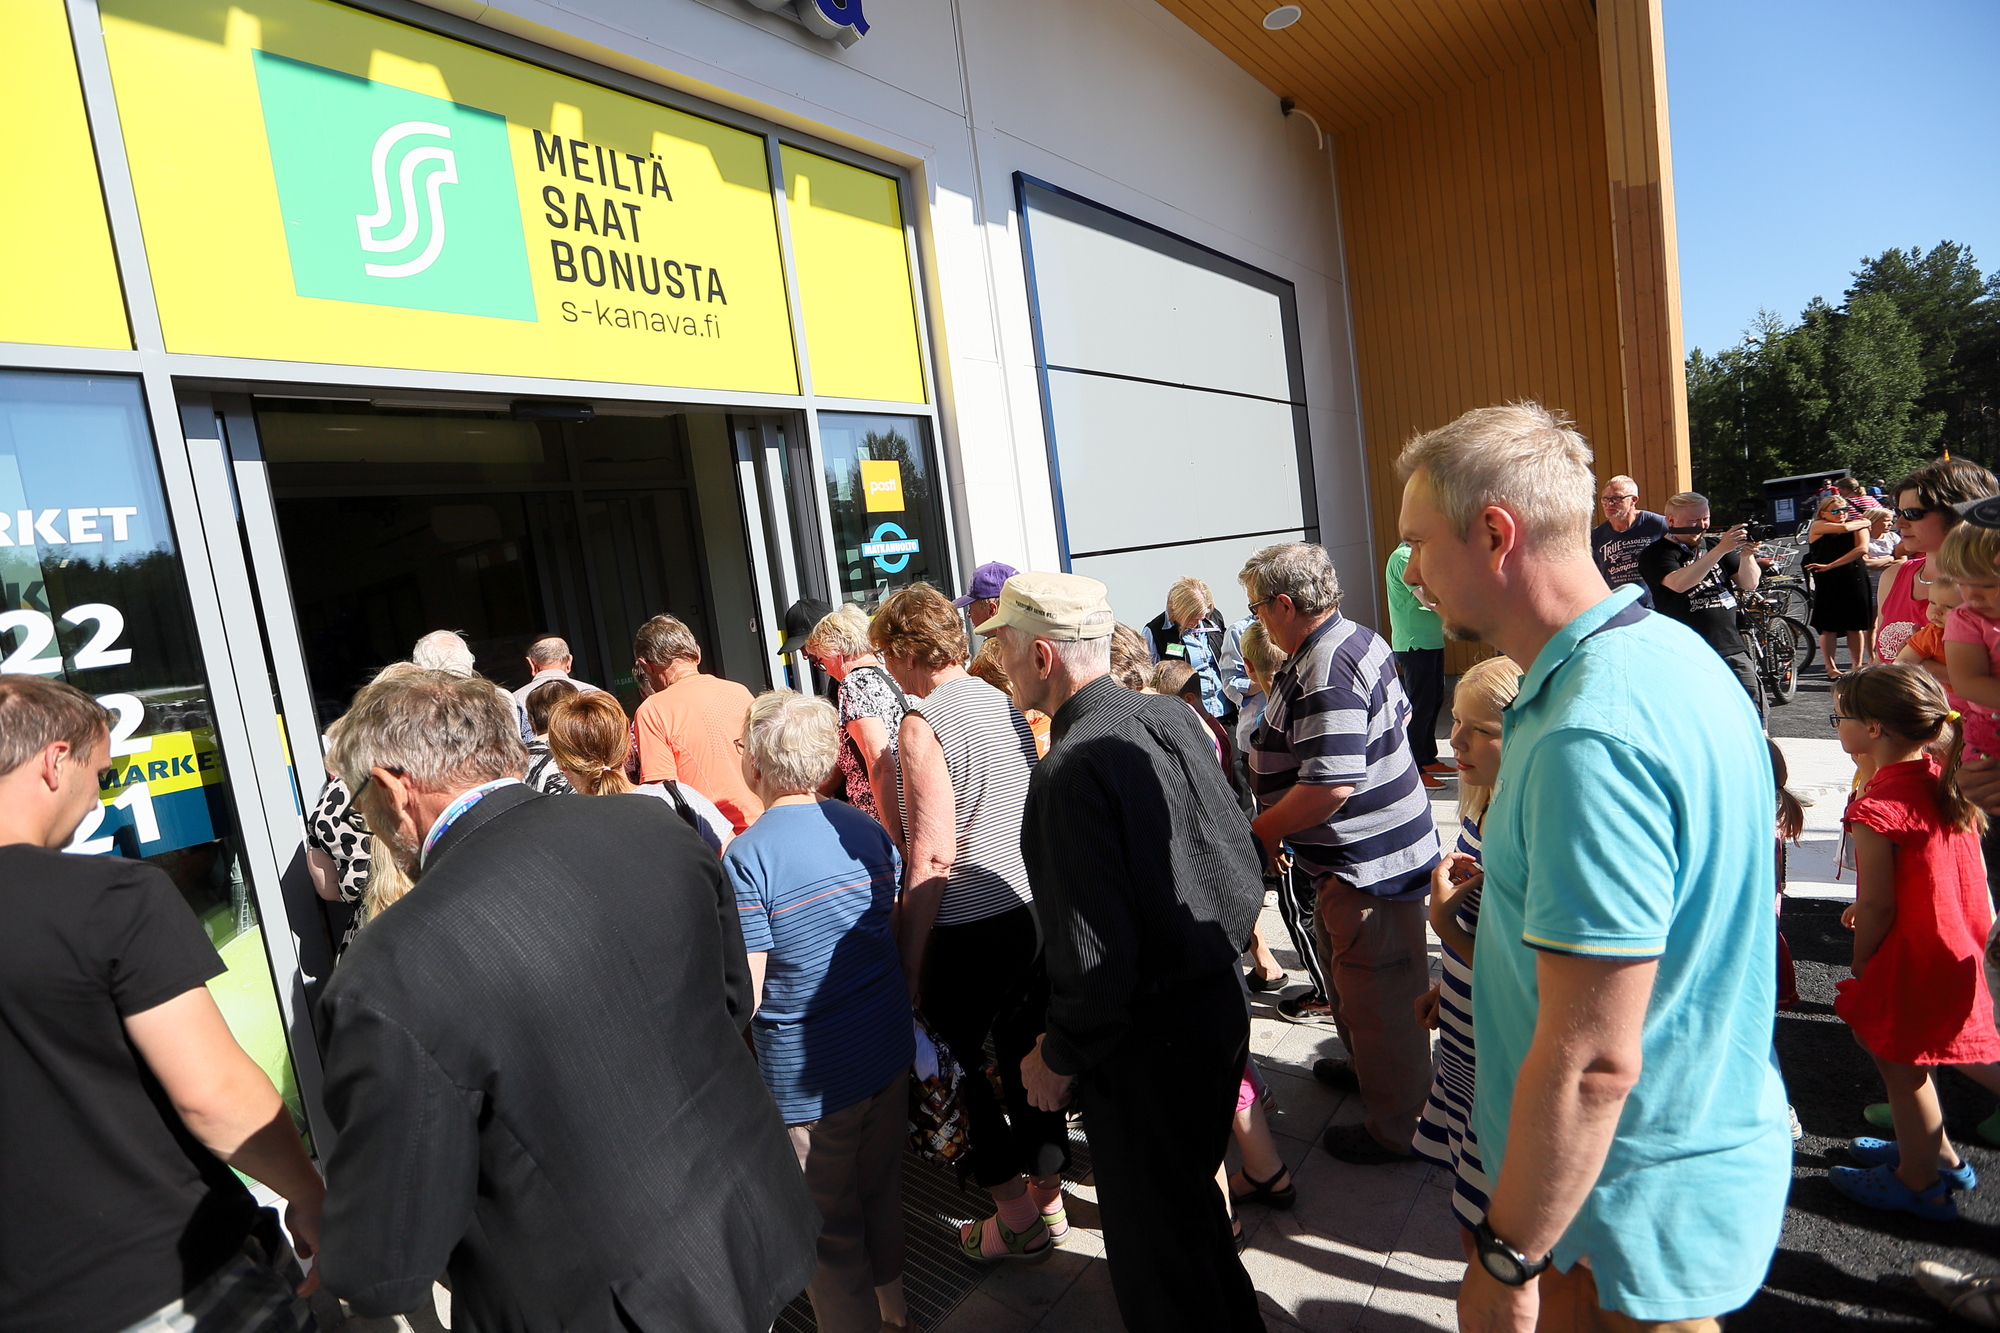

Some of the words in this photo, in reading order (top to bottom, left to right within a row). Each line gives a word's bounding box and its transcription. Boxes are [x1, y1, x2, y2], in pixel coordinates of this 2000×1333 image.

[533, 129, 673, 202] MEILTÄ
[542, 185, 641, 243] SAAT
[550, 239, 728, 306] BONUSTA
[561, 299, 721, 339] s-kanava.fi
[869, 478, 897, 496] posti
[864, 541, 917, 555] MATKAHUOLTO
[0, 603, 132, 675] 22
